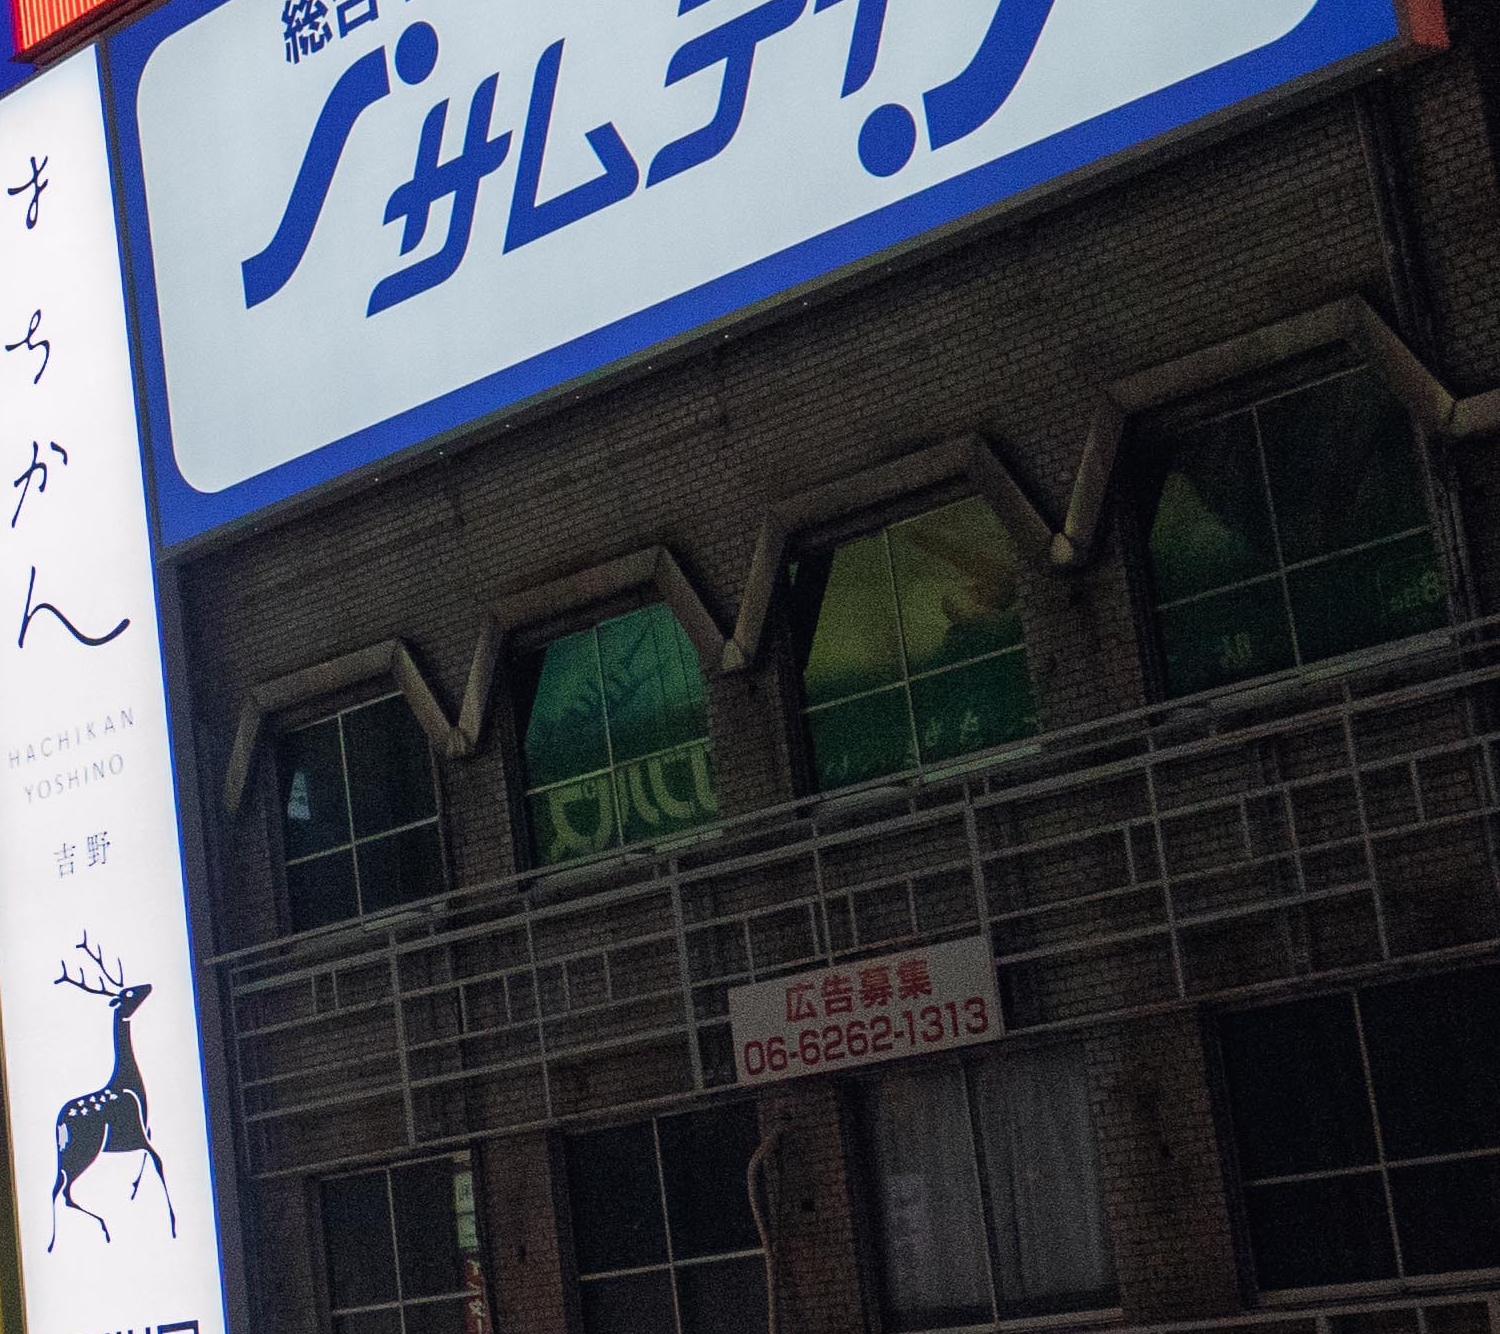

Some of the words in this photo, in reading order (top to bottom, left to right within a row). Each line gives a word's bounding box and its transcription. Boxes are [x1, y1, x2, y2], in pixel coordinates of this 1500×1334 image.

[6, 704, 137, 773] HACHIKAN
[23, 751, 126, 807] YOSHINO
[53, 829, 113, 881] 吉野
[782, 955, 934, 1024] 広告募集
[743, 996, 991, 1078] 06-6262-1313
